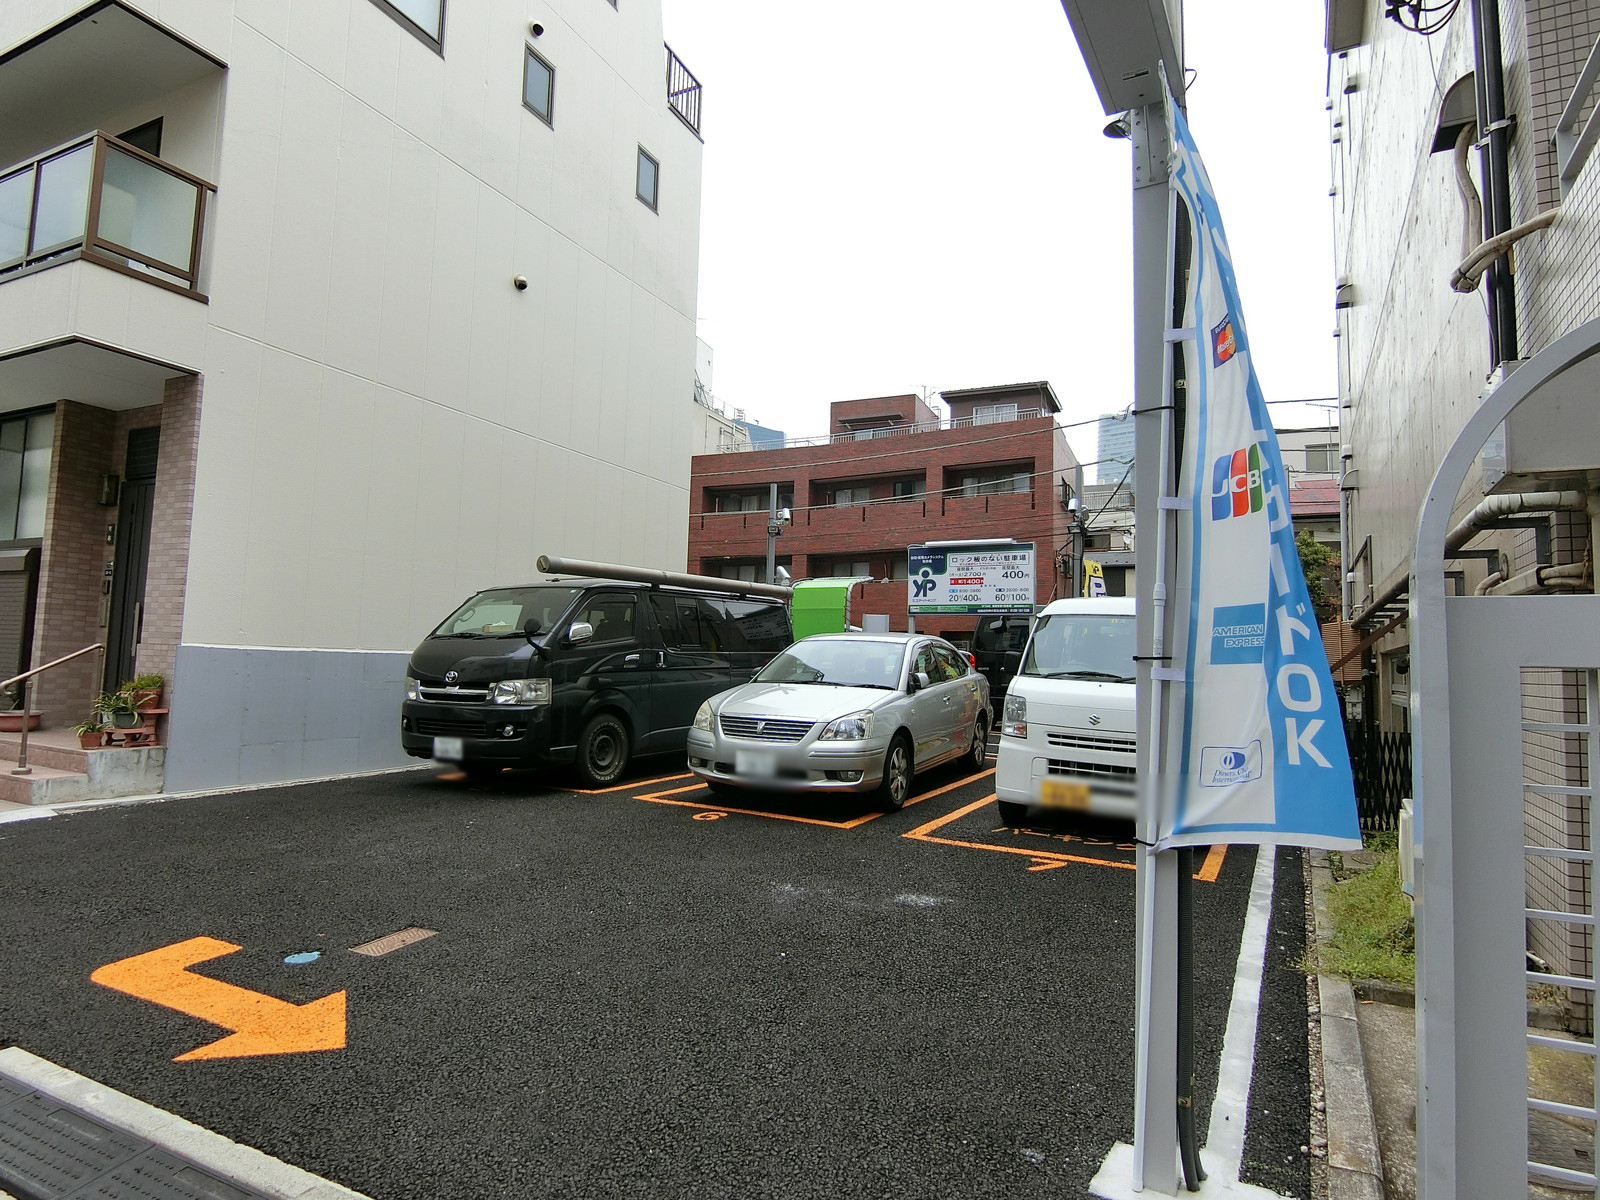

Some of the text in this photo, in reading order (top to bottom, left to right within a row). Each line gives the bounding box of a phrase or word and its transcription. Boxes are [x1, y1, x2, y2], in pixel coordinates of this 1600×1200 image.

[1213, 625, 1264, 637] AMERICAN
[1224, 636, 1265, 648] EXPRESS
[1215, 769, 1236, 777] Diners
